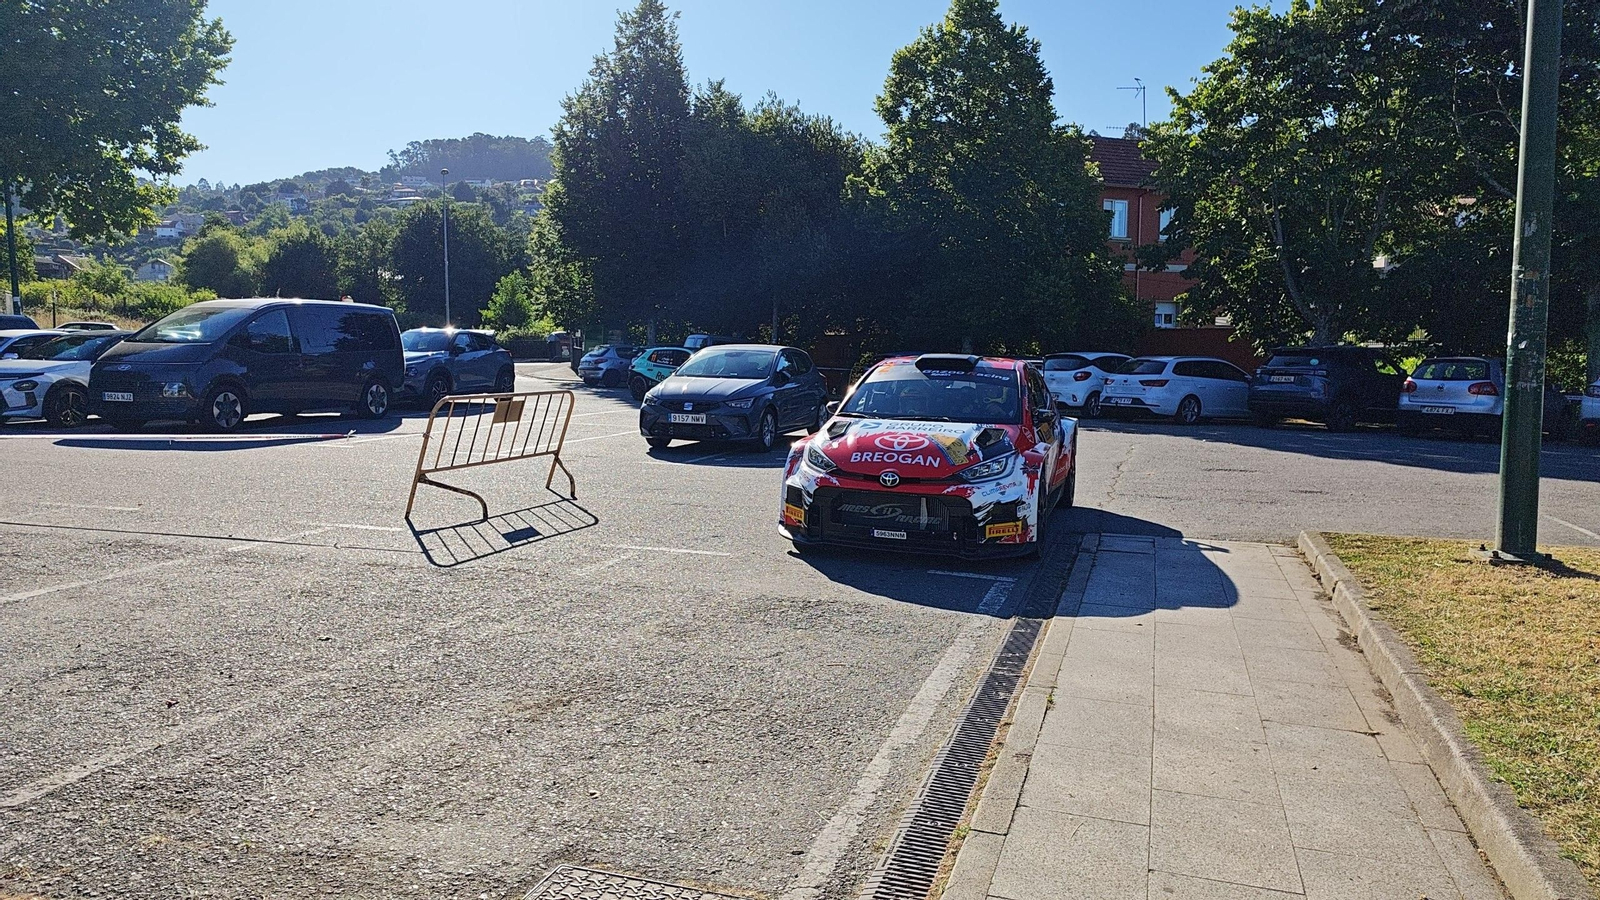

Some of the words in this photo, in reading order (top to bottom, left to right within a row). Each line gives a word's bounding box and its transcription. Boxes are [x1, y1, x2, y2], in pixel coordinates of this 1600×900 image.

[885, 425, 966, 434] BARREIRO
[850, 452, 941, 468] BREOGAN
[988, 524, 1020, 536] PIRELLI
